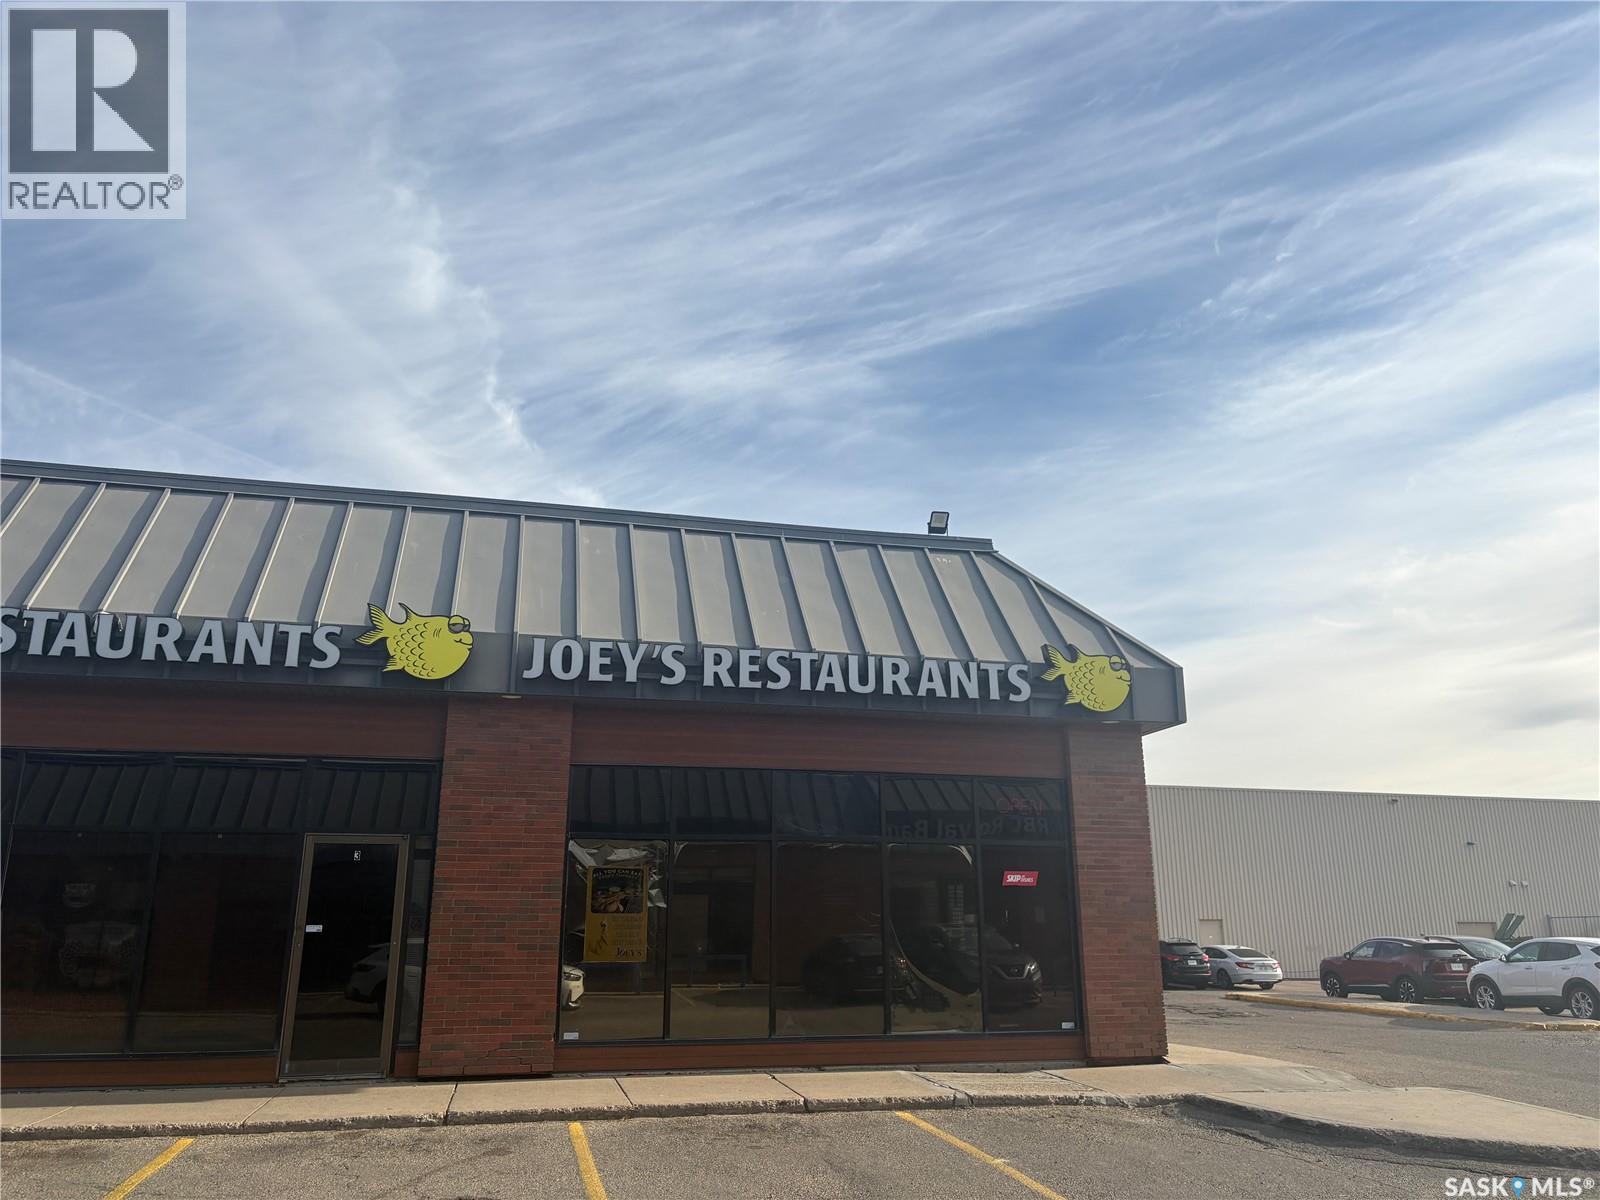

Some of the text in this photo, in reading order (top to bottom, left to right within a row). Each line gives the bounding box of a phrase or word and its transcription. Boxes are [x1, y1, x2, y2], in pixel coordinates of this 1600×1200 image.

[522, 637, 1031, 702] JOEY'S RESTAURANTS
[1006, 874, 1021, 883] SKIP
